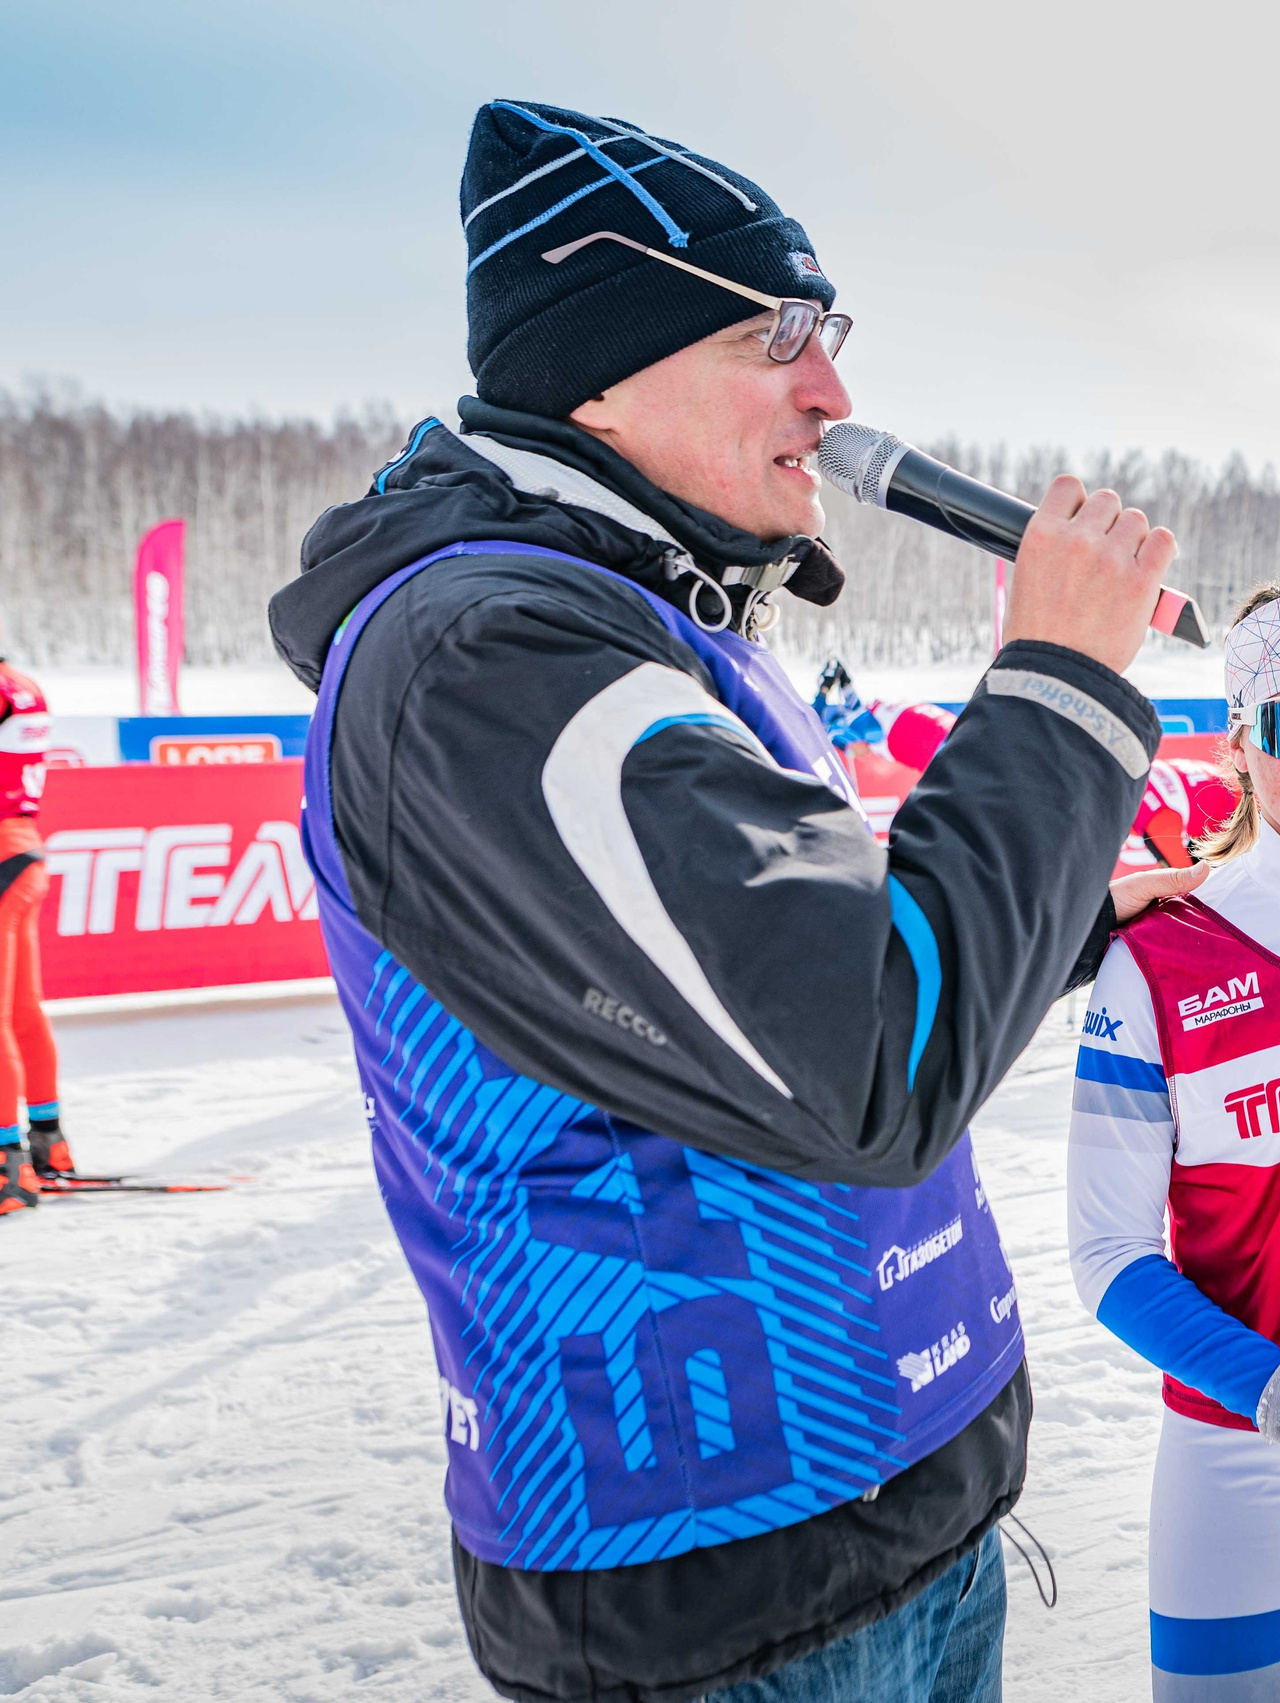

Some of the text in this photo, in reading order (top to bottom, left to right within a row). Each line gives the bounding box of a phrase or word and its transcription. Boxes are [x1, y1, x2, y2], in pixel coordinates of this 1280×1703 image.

[1178, 971, 1260, 1017] БАМ
[1194, 1002, 1252, 1026] МАРАФОНЫ
[583, 986, 667, 1047] RECCO
[930, 1320, 966, 1359] KRAS
